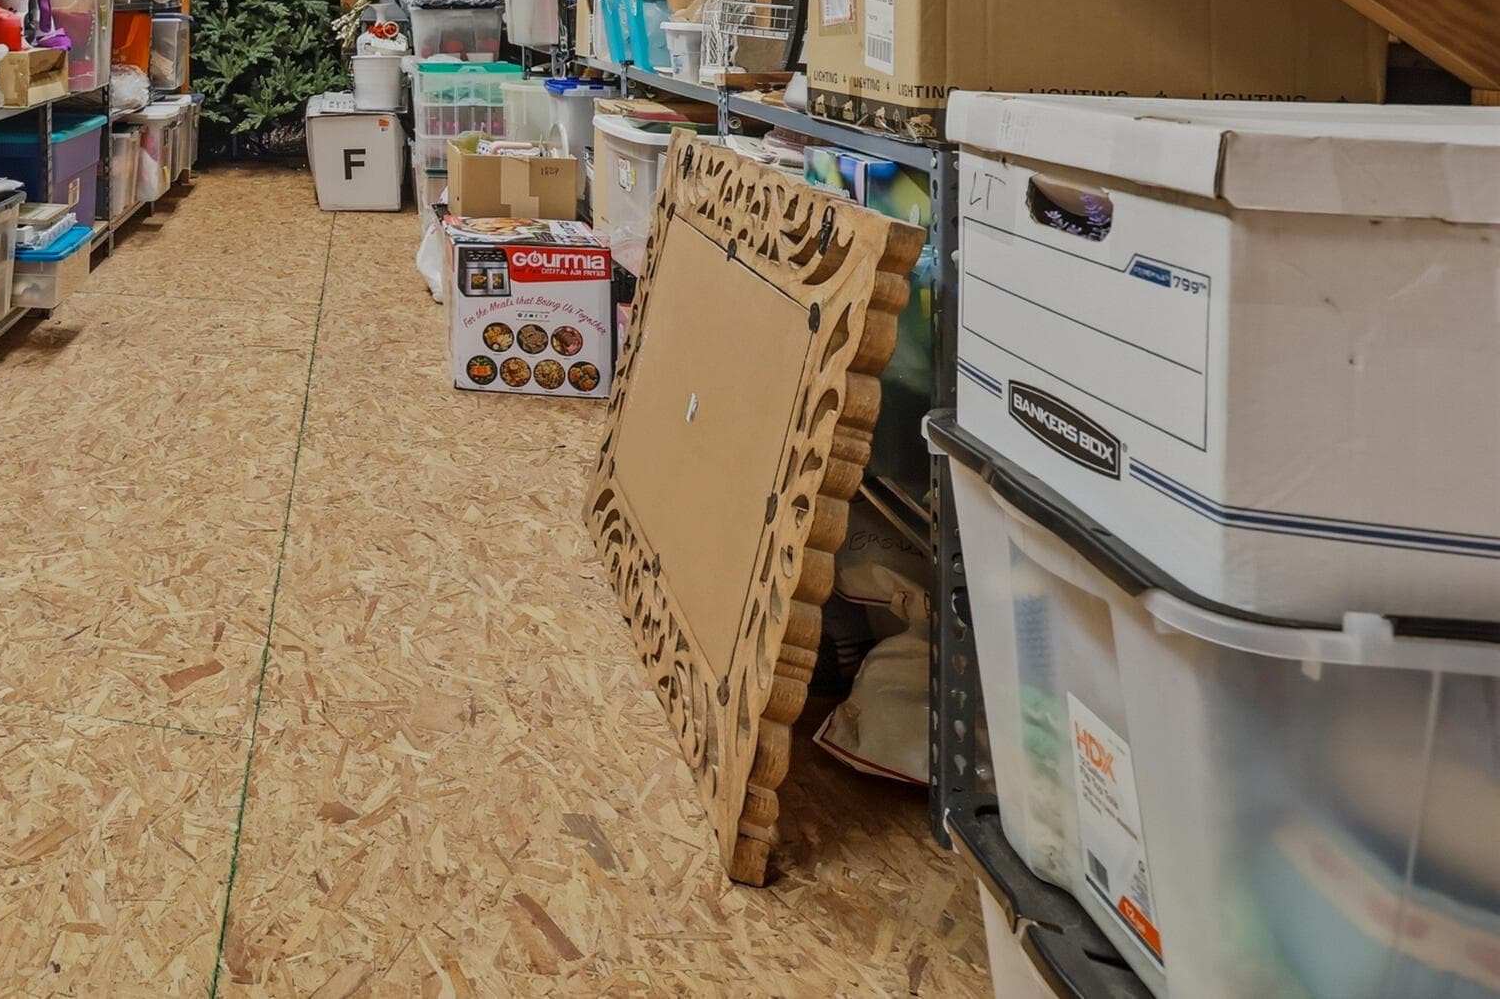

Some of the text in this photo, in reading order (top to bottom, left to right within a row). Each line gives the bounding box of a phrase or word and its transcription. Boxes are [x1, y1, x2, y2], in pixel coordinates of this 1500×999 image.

[814, 71, 838, 84] LIGHTING
[344, 148, 366, 180] F
[463, 316, 476, 329] For
[476, 307, 489, 319] the
[490, 298, 514, 313] Meals
[516, 296, 533, 306] that
[1013, 393, 1115, 465] BANKERS BOX
[1074, 720, 1117, 785] HDX
